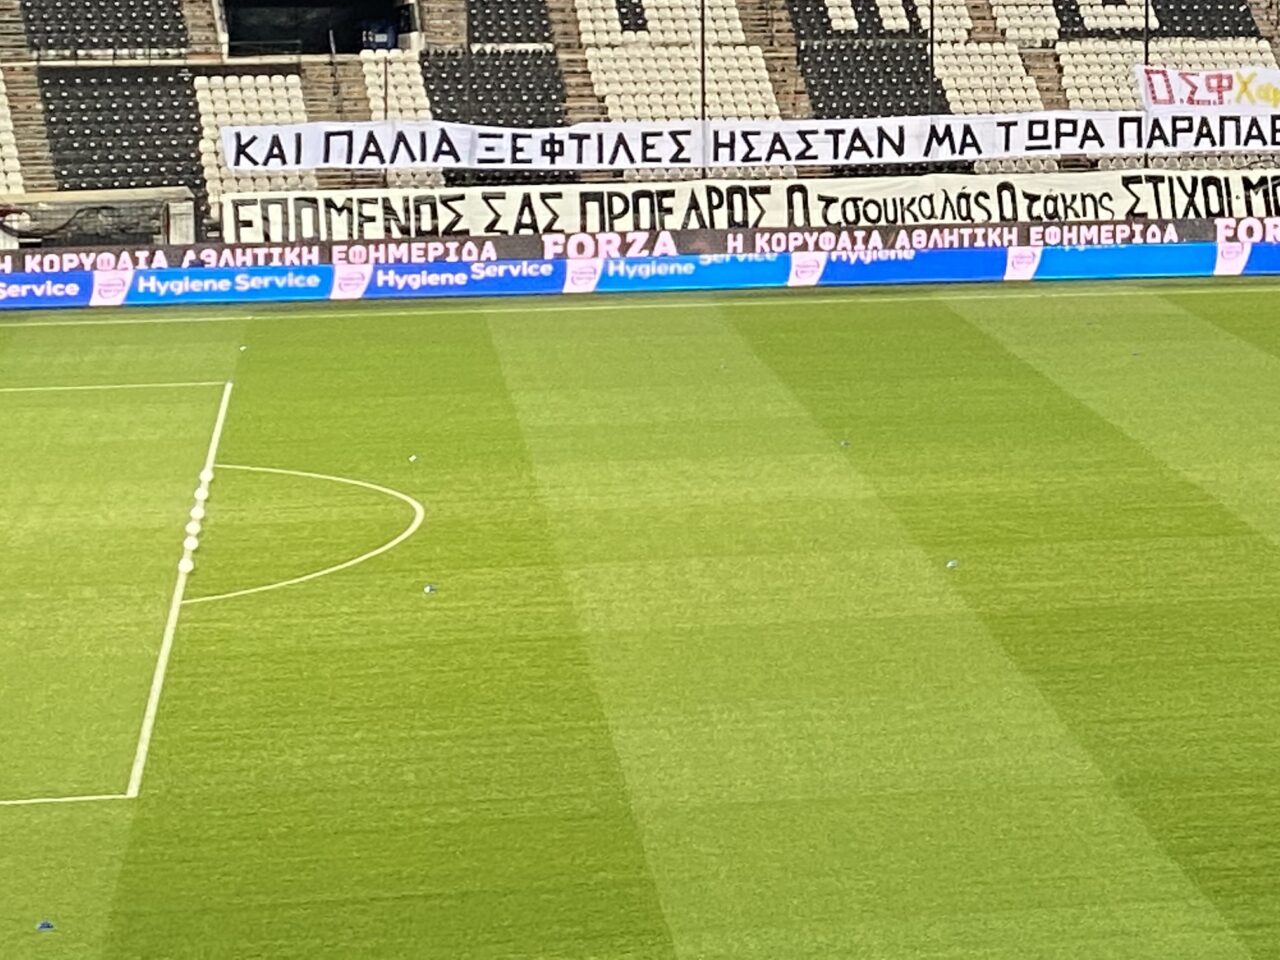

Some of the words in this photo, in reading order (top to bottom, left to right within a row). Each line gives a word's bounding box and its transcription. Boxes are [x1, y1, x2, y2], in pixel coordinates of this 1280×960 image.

[233, 131, 303, 166] ΚΑΙ
[322, 127, 461, 165] ΠΑΛΙΑ
[477, 130, 692, 165] ΞΕΦΤΙΛΕΣ
[713, 125, 905, 162] ΗΣΑΣΤΑΝ
[923, 123, 982, 157] ΜΑ
[996, 117, 1105, 152] ΤΩΡΑ
[231, 193, 470, 243] ΕΠΟΜΕΝΟΣ
[481, 191, 566, 235] ΣΑΣ
[541, 230, 679, 260] FORZA
[727, 233, 743, 253] Η
[755, 229, 883, 253] ΚΟΡΥΦΑΙΑ
[894, 226, 1018, 250] ΑΘΛΗΤΙΚΗ
[1029, 222, 1179, 247] ΕΦΗΜΕΡΙΔΑ
[138, 273, 232, 297] Hygiene
[234, 272, 321, 292] Service
[377, 269, 468, 291] Hygiene
[470, 260, 554, 279] Service
[608, 259, 695, 280] Hygiene
